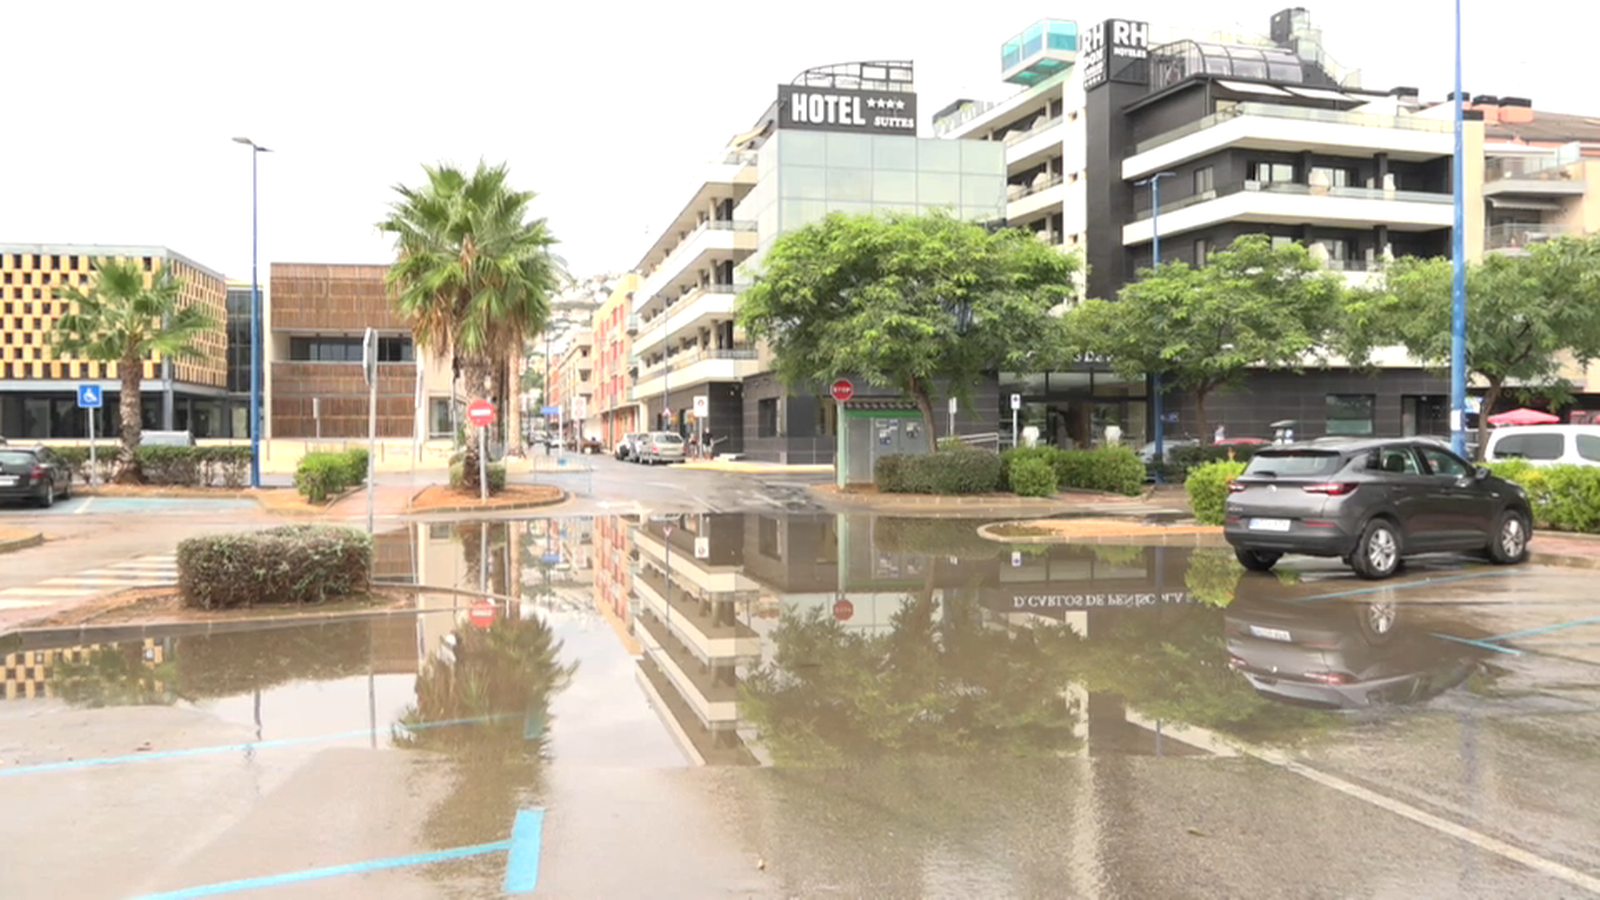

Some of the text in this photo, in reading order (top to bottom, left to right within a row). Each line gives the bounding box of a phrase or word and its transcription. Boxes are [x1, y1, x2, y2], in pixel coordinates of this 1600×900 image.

[1083, 23, 1104, 53] RH
[1113, 21, 1147, 47] RH
[1113, 47, 1147, 58] HOTELES
[792, 93, 866, 125] HOTEL
[874, 116, 914, 128] SUITES
